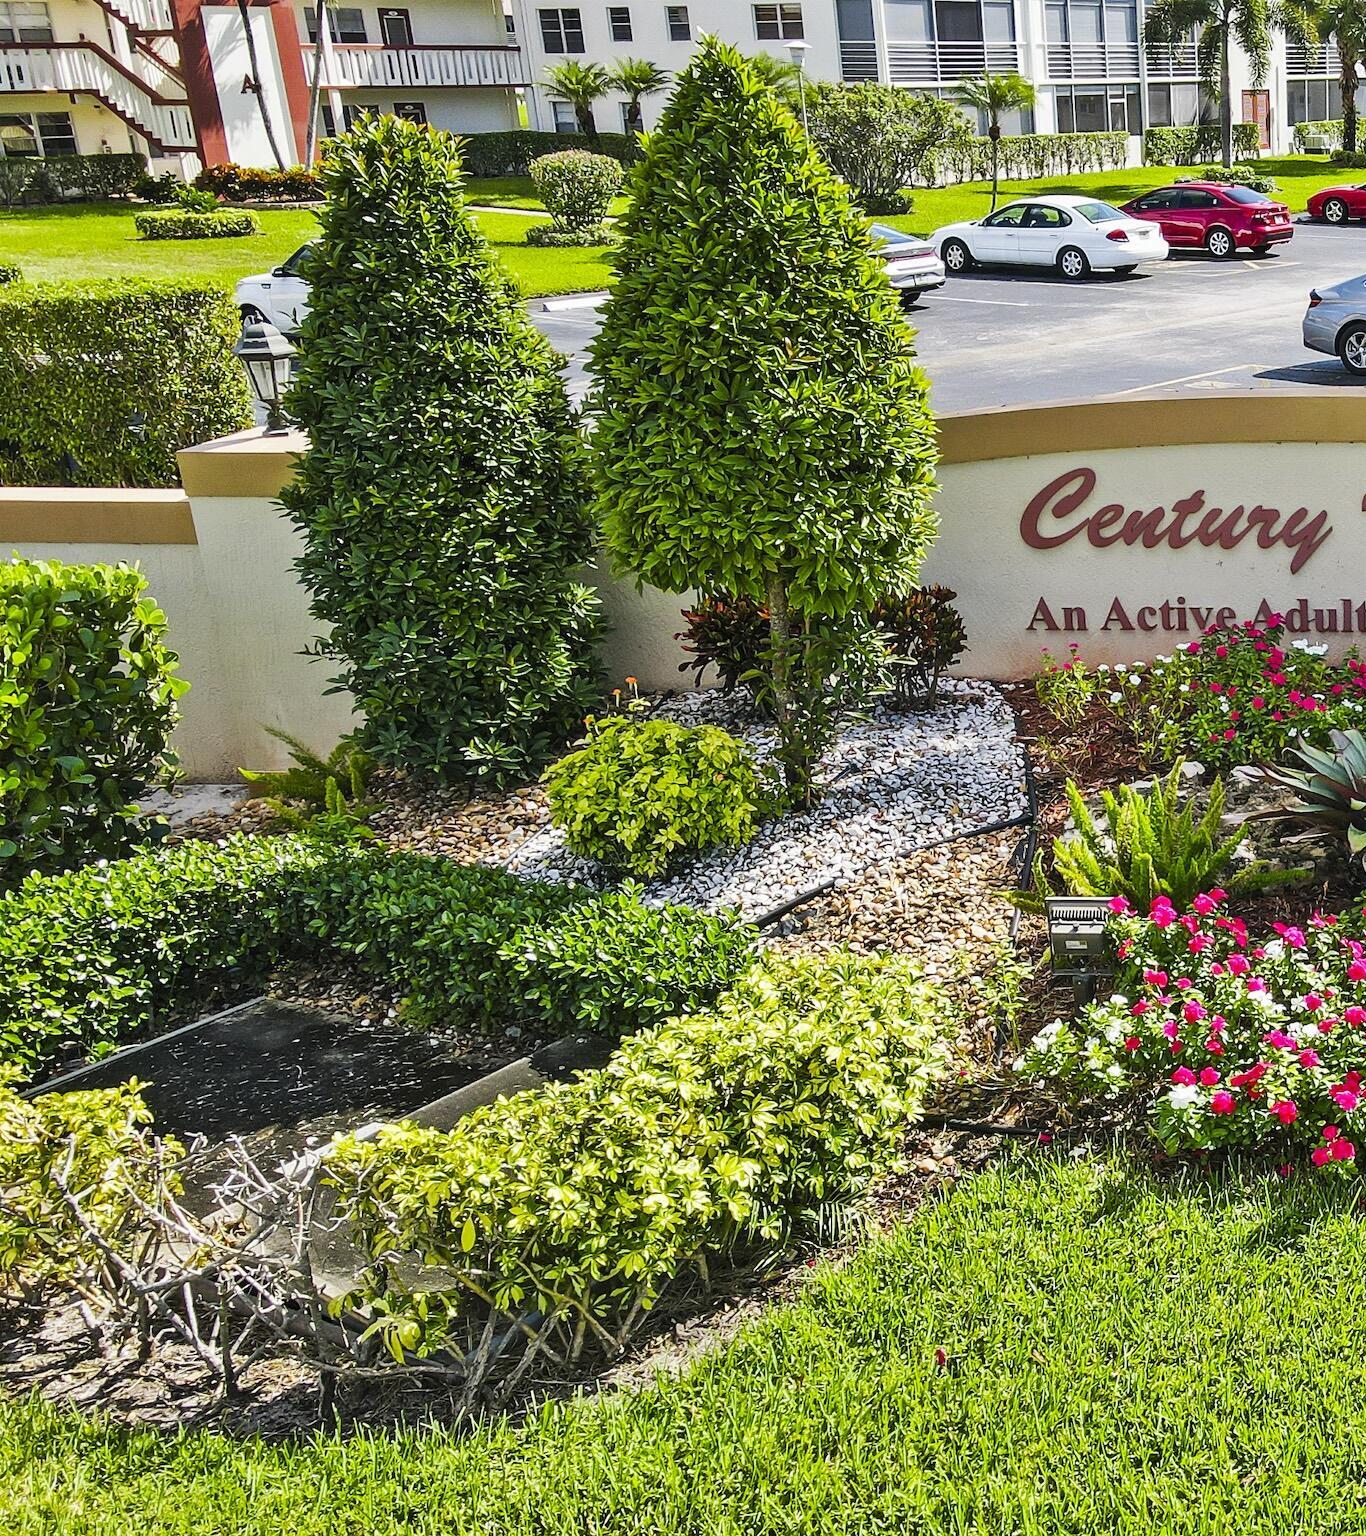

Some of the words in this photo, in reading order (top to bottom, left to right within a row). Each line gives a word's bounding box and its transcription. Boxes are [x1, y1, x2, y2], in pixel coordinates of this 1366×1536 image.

[240, 73, 260, 94] A
[1019, 466, 1333, 575] Century
[1026, 596, 1089, 632] An
[1100, 596, 1237, 633] Active
